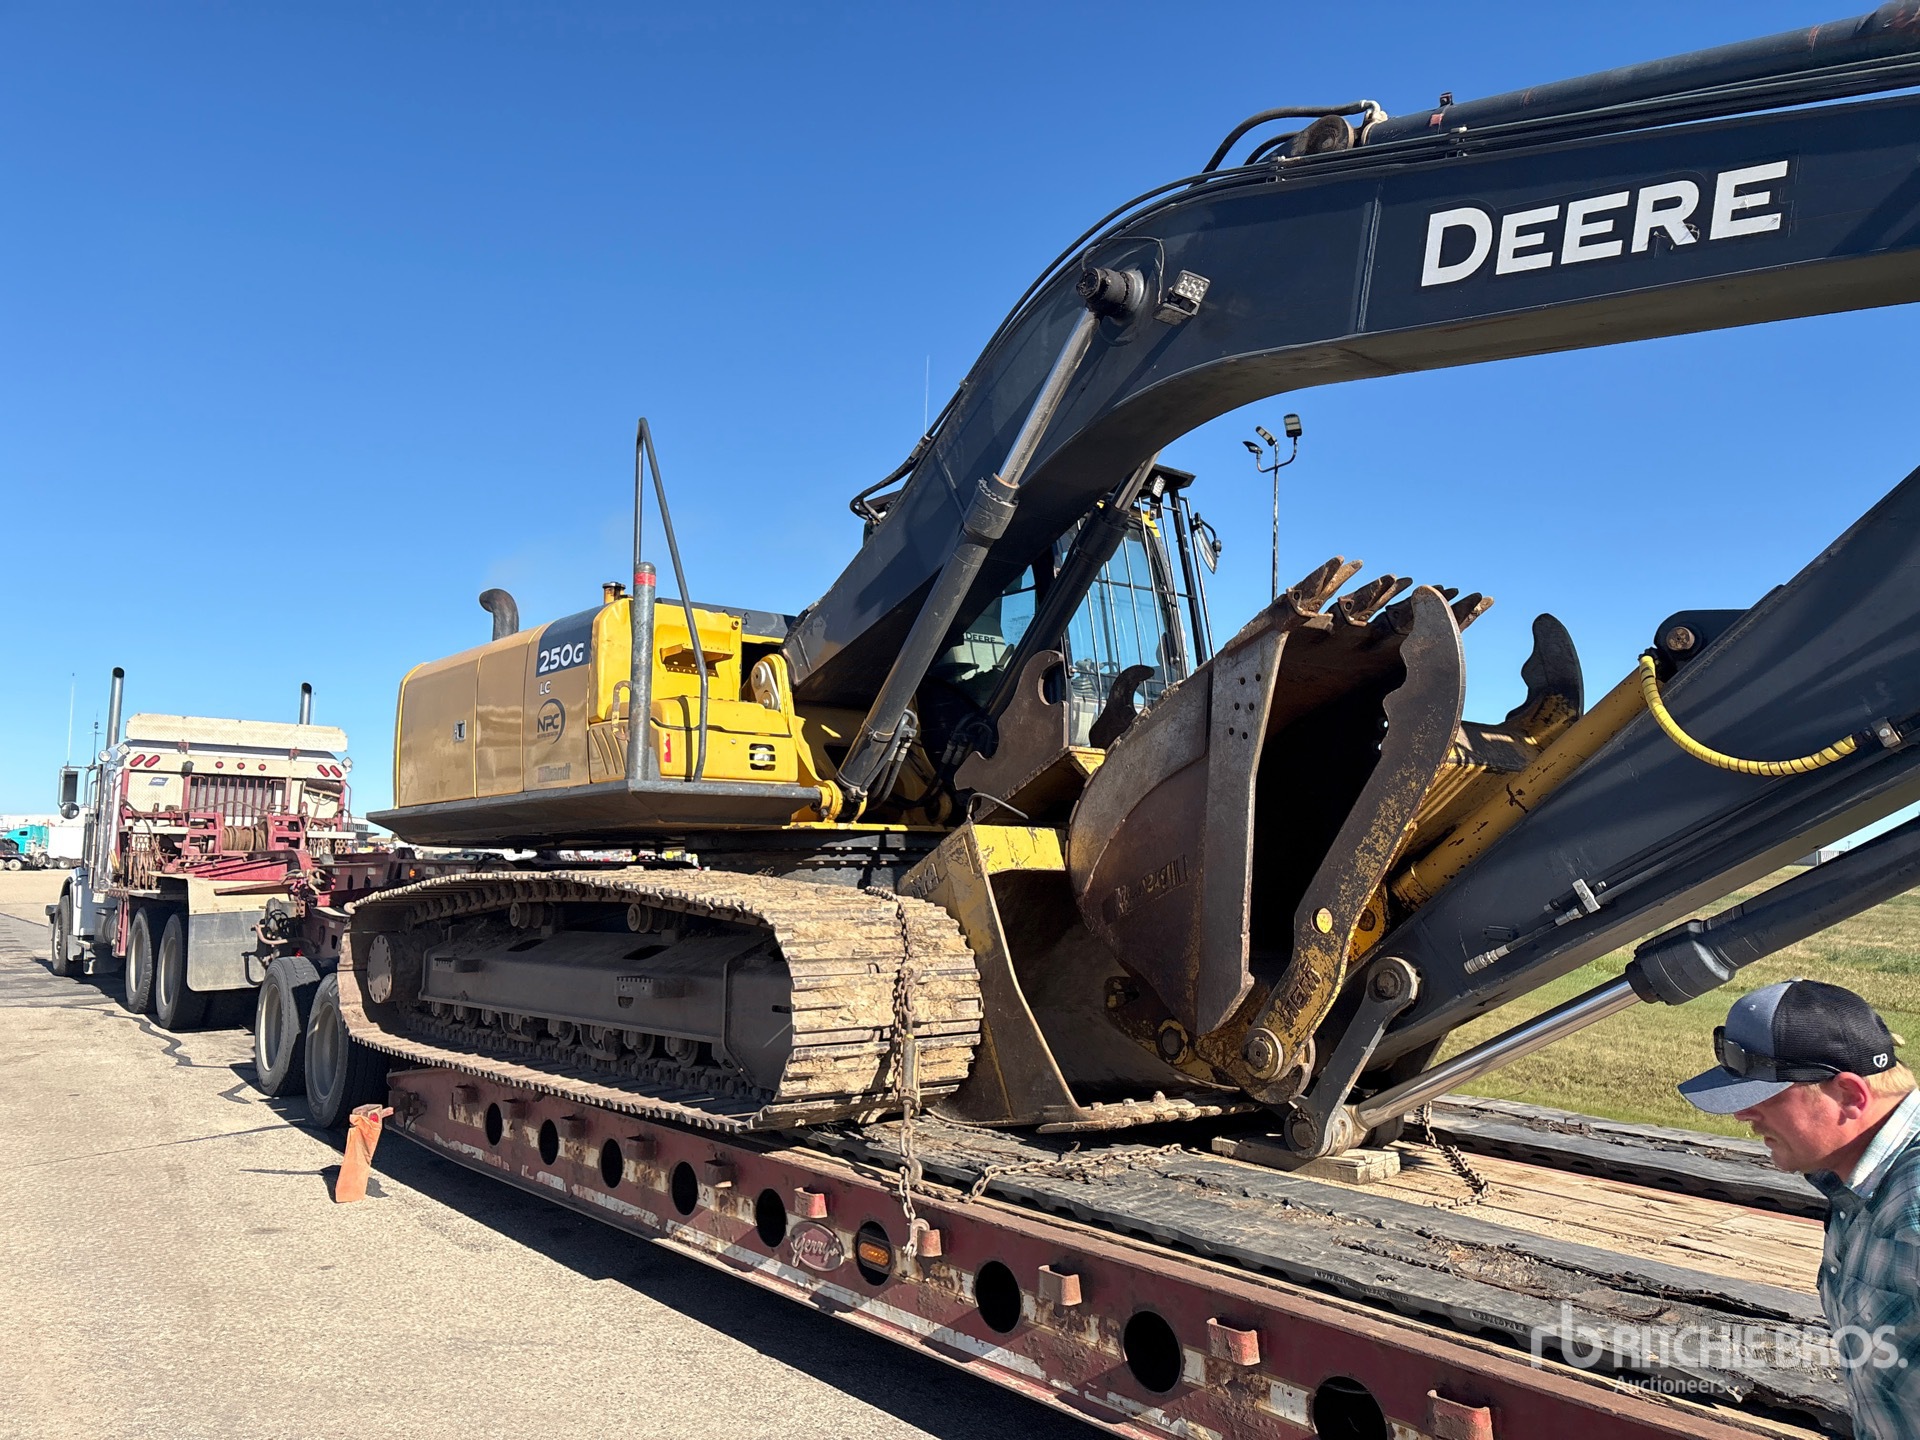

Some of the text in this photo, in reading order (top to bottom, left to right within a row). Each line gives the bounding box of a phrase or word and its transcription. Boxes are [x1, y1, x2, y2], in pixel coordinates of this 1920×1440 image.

[1421, 160, 1789, 288] DEERE
[965, 631, 996, 643] DEERE
[539, 642, 585, 673] 250G
[539, 680, 551, 695] LC
[537, 713, 560, 734] NPC
